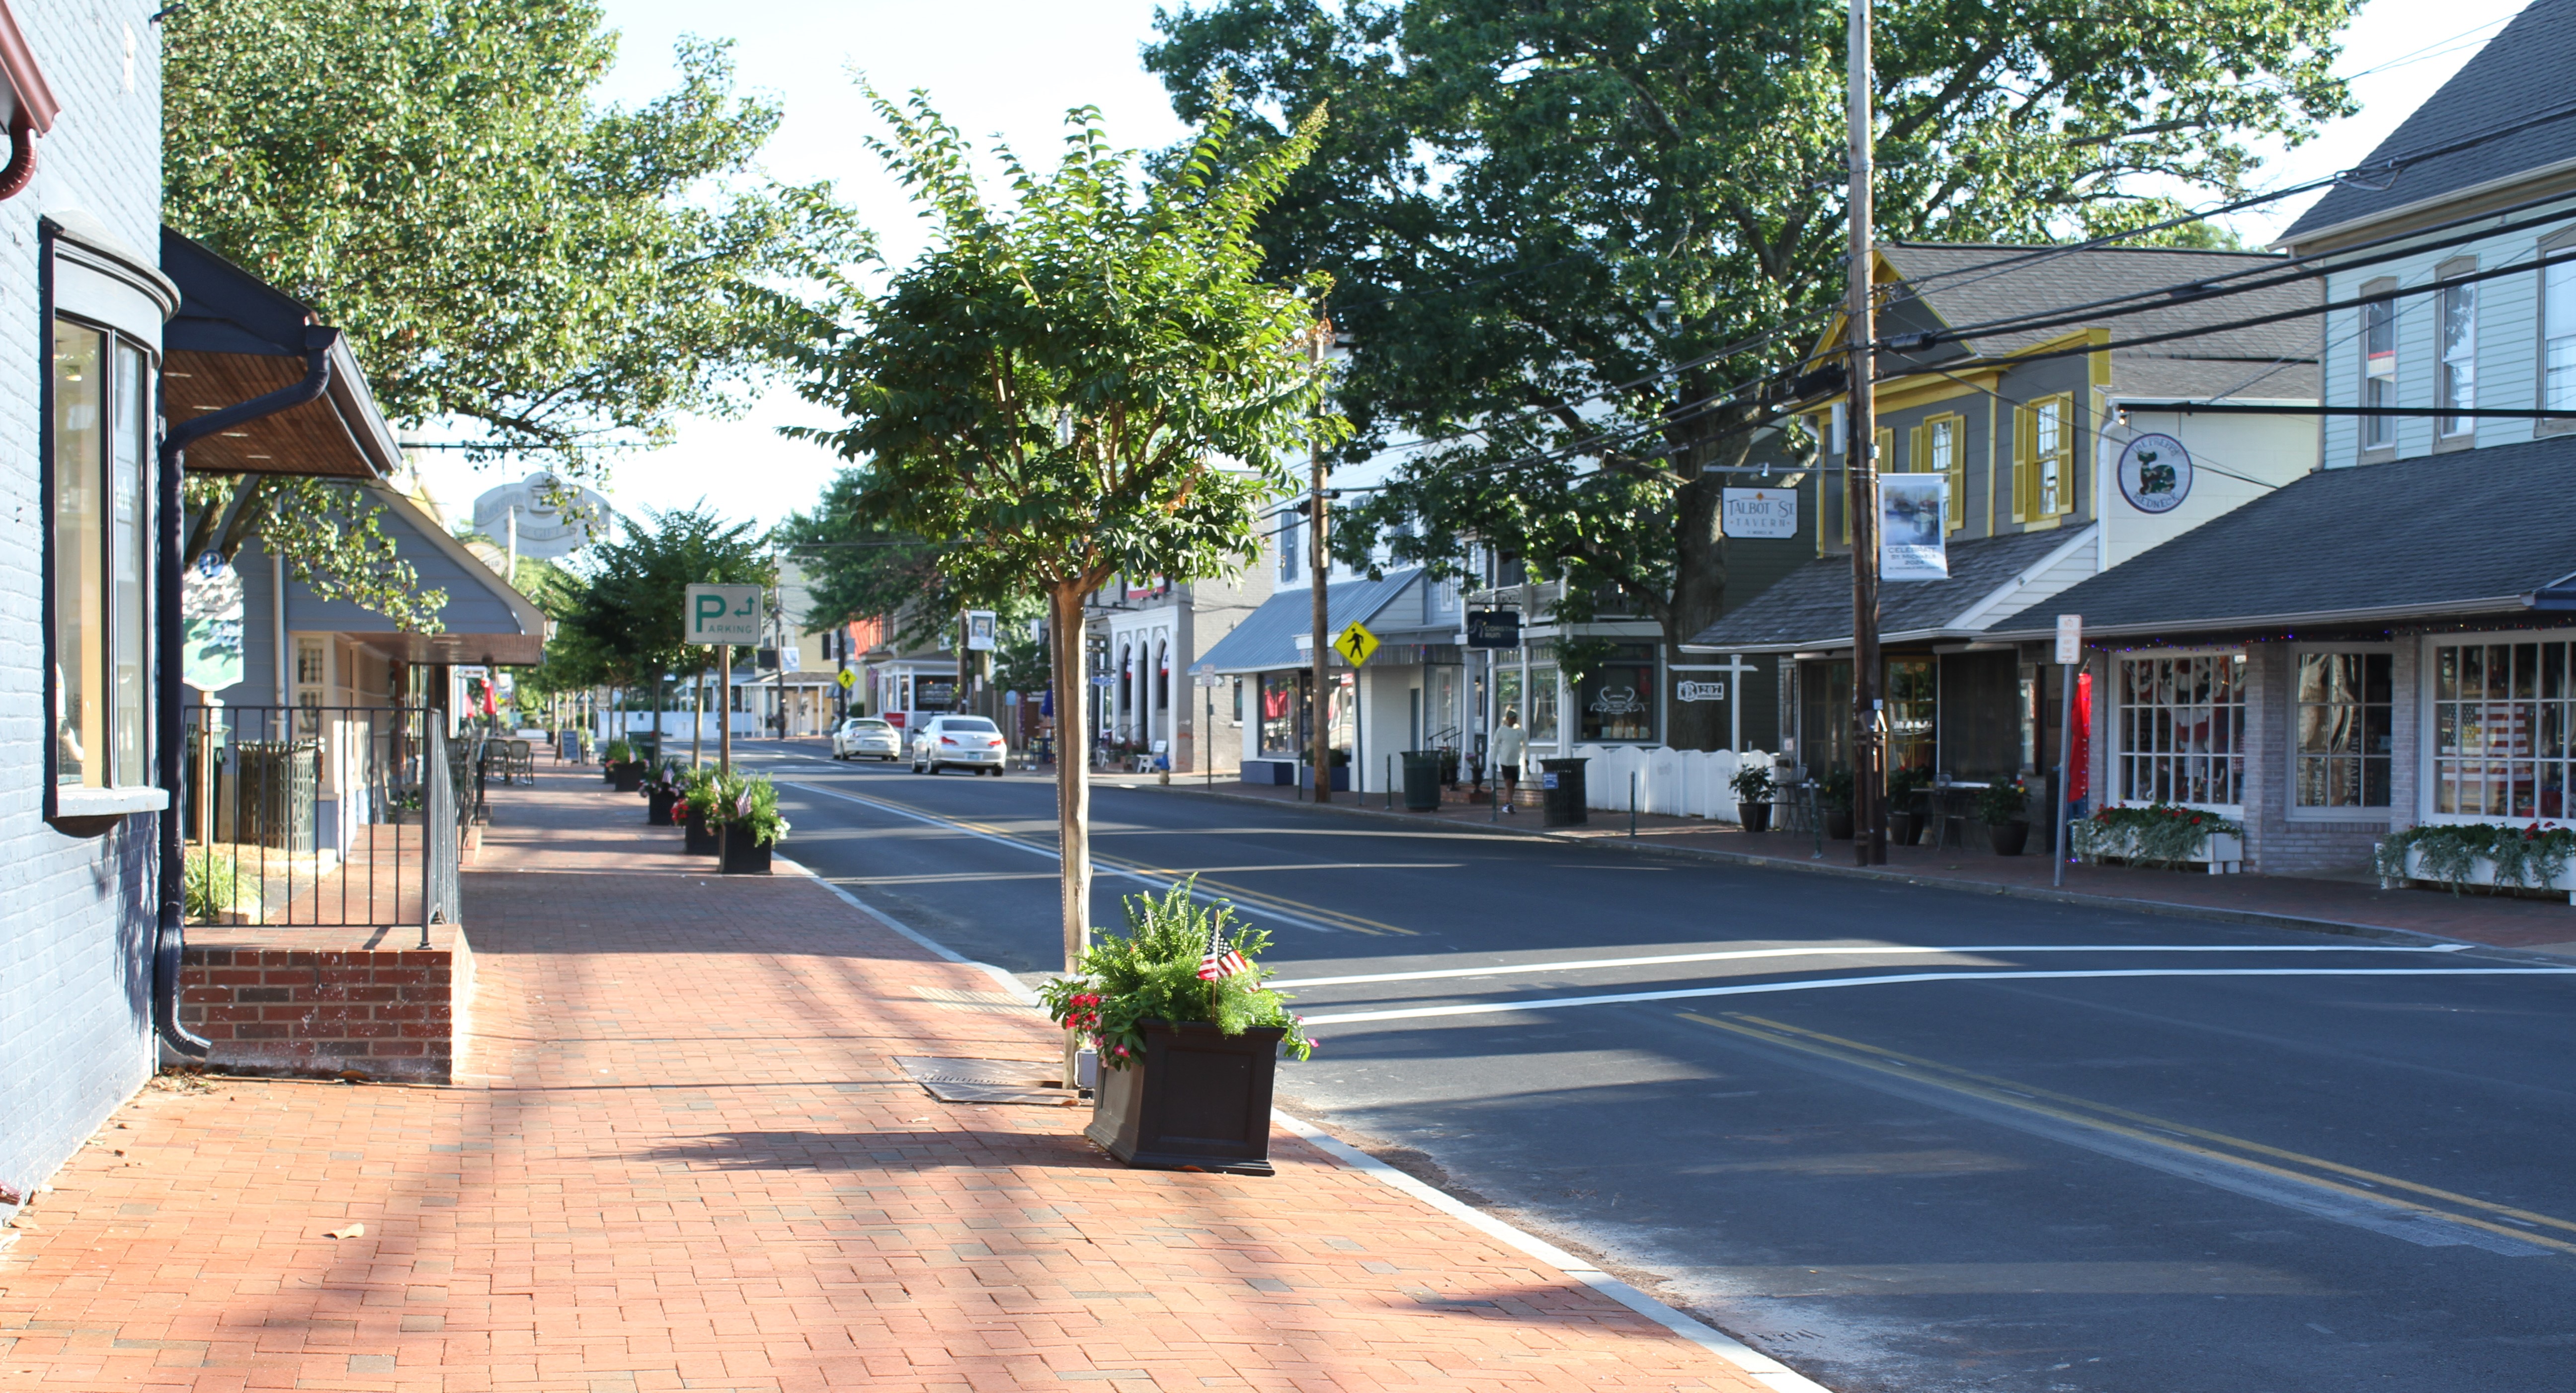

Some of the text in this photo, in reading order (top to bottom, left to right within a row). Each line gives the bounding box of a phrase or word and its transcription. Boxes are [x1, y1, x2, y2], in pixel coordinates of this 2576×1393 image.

[2135, 492, 2179, 508] REDNECK
[1726, 499, 1770, 516] TALBOT
[1736, 518, 1785, 527] TAVERN
[533, 527, 560, 538] GIFT
[1701, 686, 1719, 694] 207
